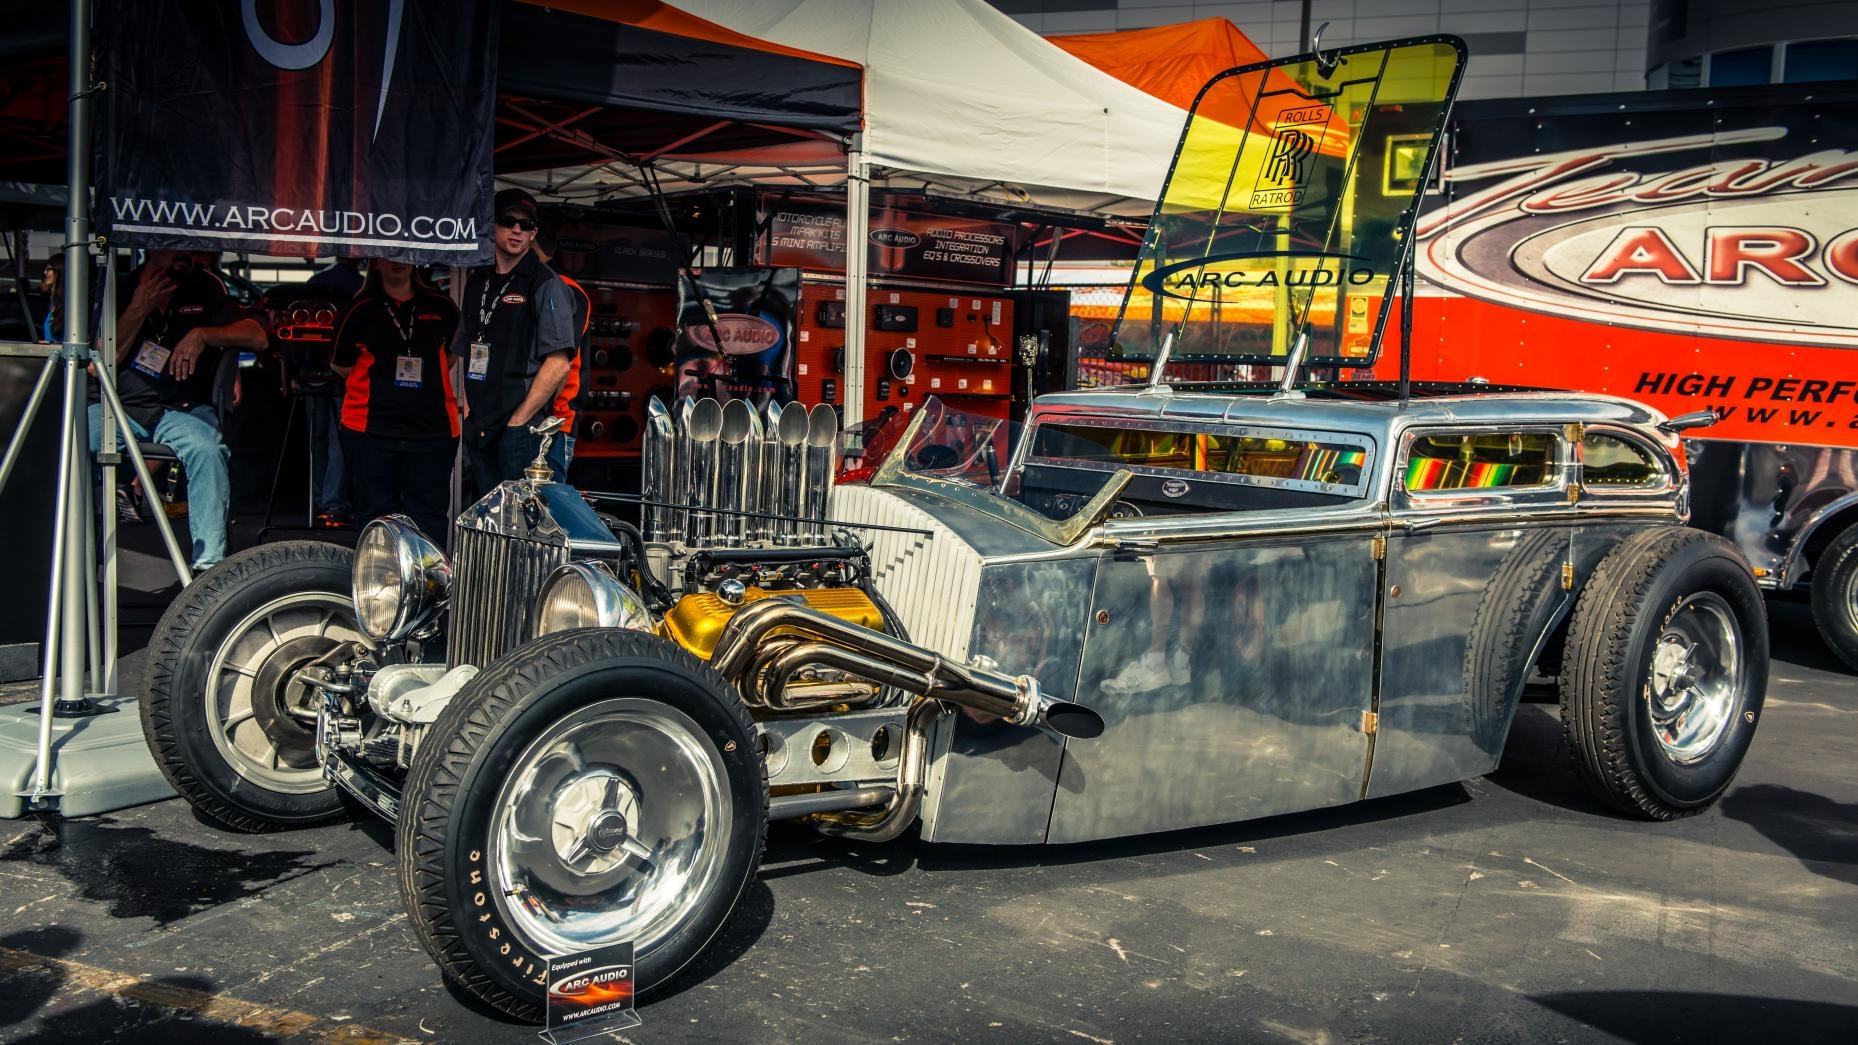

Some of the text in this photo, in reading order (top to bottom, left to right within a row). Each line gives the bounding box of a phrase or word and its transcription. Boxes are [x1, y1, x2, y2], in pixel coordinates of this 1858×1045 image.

[1284, 108, 1324, 123] ROLLS
[1251, 190, 1303, 206] RATROD
[110, 197, 477, 240] WWW.ARCAUDIO.COM
[818, 230, 841, 240] KITS
[877, 233, 917, 244] ARC AUDIO
[926, 228, 1006, 245] AUDIO PROCESSORS
[780, 237, 805, 248] MINI
[807, 241, 848, 252] AMPLIFI
[934, 240, 990, 254] INTEGRATION
[950, 253, 1001, 267] CROSSOVERS
[1175, 268, 1375, 289] ARC AUDIO
[733, 327, 775, 344] AUDIO
[1634, 372, 1736, 398] HIGH
[469, 849, 548, 986] Firestone
[551, 956, 592, 972] Equipped with
[564, 969, 628, 992] ARC AUDIO
[562, 1002, 621, 1022] WWW.ARCAUDIO.COM
